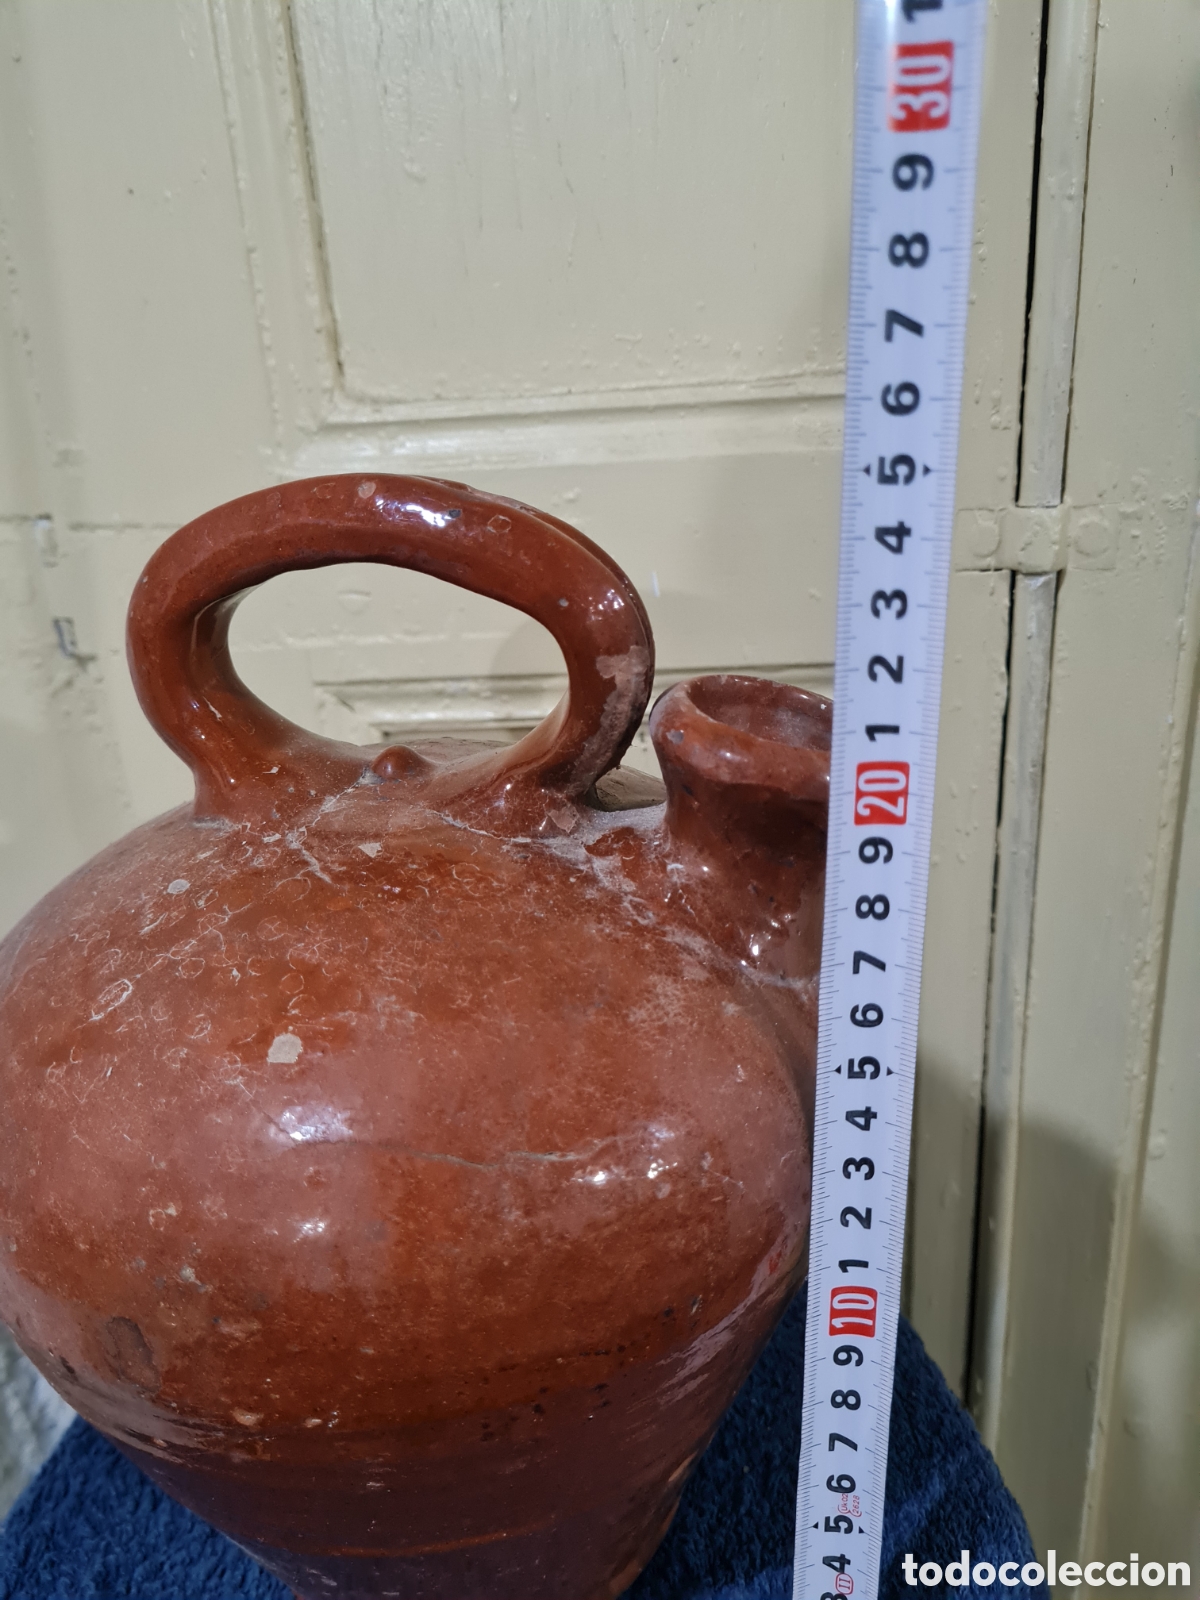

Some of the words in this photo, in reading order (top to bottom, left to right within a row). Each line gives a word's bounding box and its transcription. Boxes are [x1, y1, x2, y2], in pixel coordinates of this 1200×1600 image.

[888, 52, 950, 121] 30
[894, 154, 933, 190] 9
[890, 233, 928, 267] 8
[886, 310, 923, 341] 7
[882, 383, 919, 415] 6
[878, 455, 915, 484] 5
[875, 522, 911, 553] 4
[871, 590, 907, 618] 3
[868, 656, 903, 682] 2
[866, 725, 899, 741] 1
[856, 769, 907, 817] 20
[859, 837, 893, 863] 9
[856, 895, 890, 920] 8
[853, 951, 886, 974] 7
[850, 1004, 883, 1027] 6
[848, 1057, 880, 1079] 5
[846, 1107, 877, 1131] 4
[843, 1157, 874, 1180] 3
[840, 1207, 871, 1229] 2
[838, 1260, 868, 1273] 1
[831, 1292, 875, 1329] 10
[833, 1345, 863, 1366] 9
[831, 1390, 861, 1410] 8
[829, 1433, 857, 1451] 7
[826, 1474, 856, 1494] 6
[824, 1515, 853, 1534] 5
[823, 1554, 850, 1574] 4
